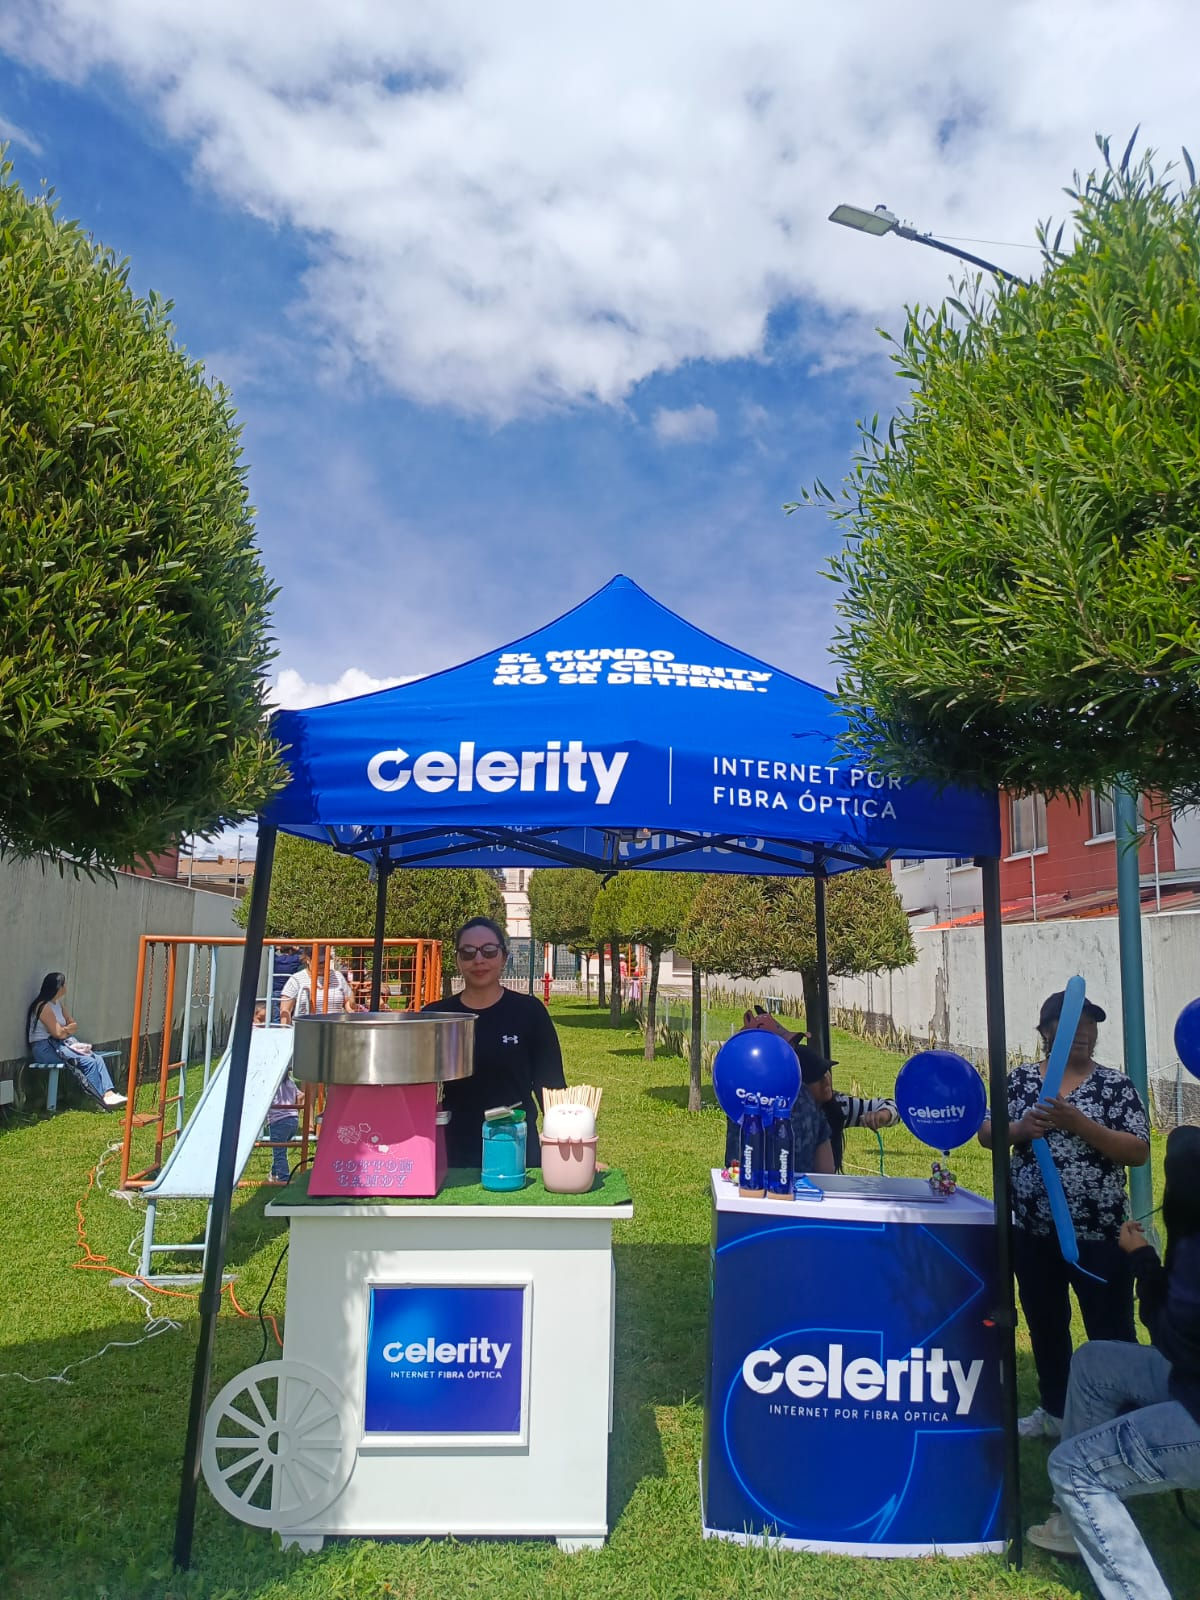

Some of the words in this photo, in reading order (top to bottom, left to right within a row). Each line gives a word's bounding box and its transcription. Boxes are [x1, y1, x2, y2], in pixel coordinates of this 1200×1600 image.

[499, 653, 537, 663] EL
[545, 648, 675, 662] MUNDO
[495, 663, 541, 675] DE
[550, 660, 602, 673] UN
[610, 660, 772, 682] CELERITY
[493, 673, 548, 685] NO
[558, 673, 597, 684] SE
[606, 672, 768, 693] DETIENE.
[713, 756, 839, 785] INTERNET
[850, 768, 902, 791] POR
[713, 786, 788, 811] FIBRA
[798, 789, 897, 820] ÓPTICA
[333, 1159, 413, 1173] COTTON
[338, 1174, 407, 1187] CANDY
[390, 1370, 435, 1379] INTERNET
[438, 1371, 464, 1379] FIBRA
[467, 1369, 502, 1379] ÓPTICA
[769, 1404, 828, 1418] INTERNET
[834, 1408, 859, 1420] POR
[864, 1409, 899, 1421] FIBRA
[904, 1410, 949, 1422] ÓPTICA
